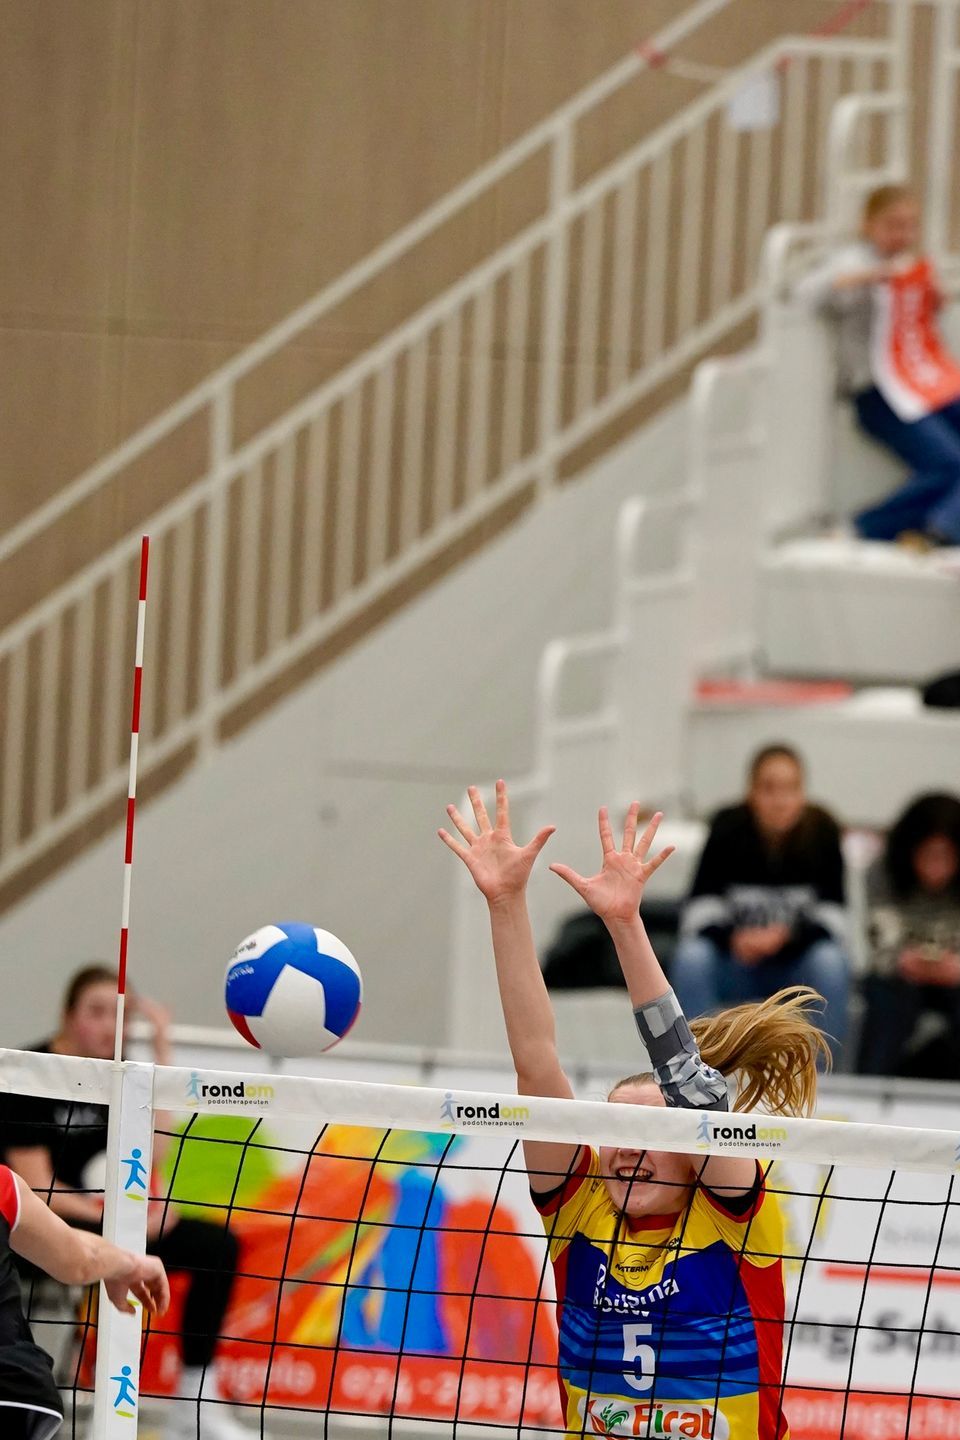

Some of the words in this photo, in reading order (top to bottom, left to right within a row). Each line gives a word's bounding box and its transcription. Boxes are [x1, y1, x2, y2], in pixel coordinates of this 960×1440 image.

[202, 1081, 274, 1098] rondom
[456, 1102, 529, 1119] rondom
[713, 1123, 787, 1140] rondom
[622, 1323, 656, 1391] 5
[632, 1403, 714, 1439] Firat
